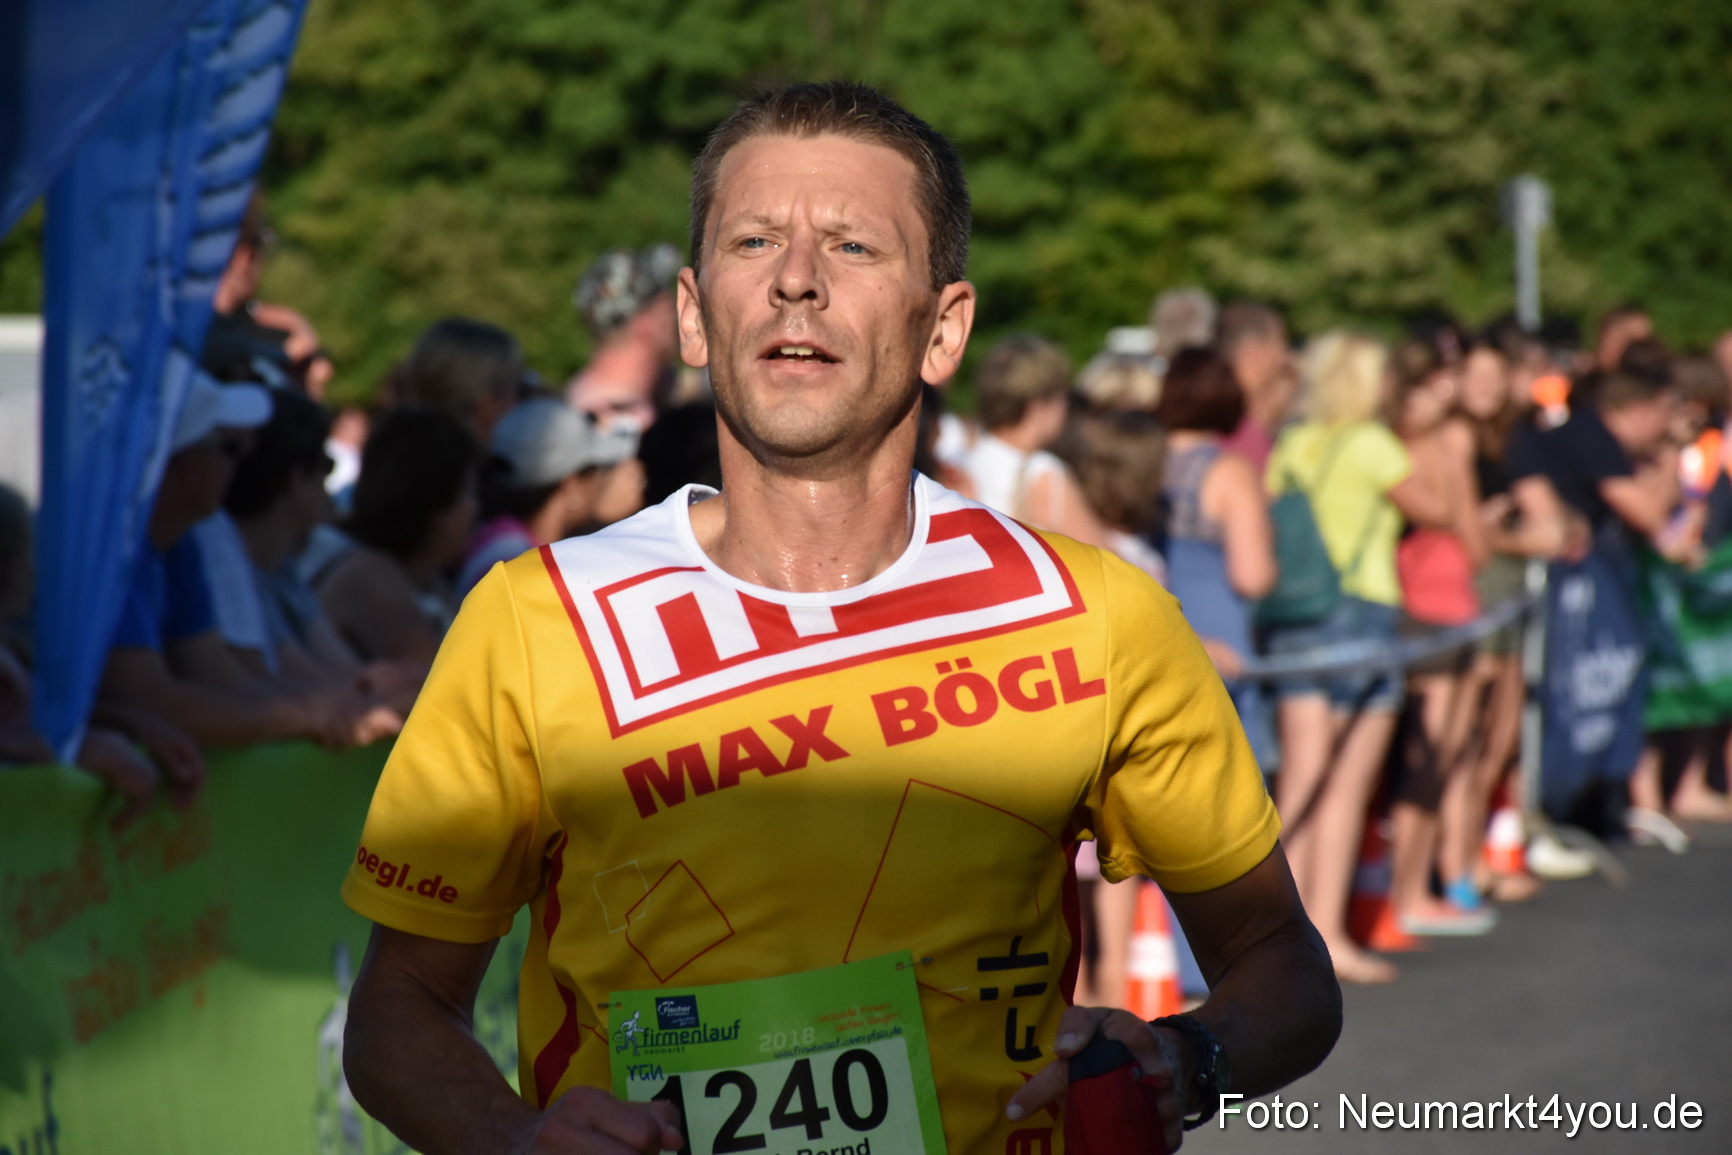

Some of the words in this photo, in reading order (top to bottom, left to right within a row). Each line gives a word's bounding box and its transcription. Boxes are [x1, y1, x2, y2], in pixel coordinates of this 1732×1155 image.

[622, 705, 851, 819] MAX
[871, 647, 1106, 747] BÖGL
[355, 843, 458, 903] oegl.de
[643, 1019, 741, 1046] firmenlauf
[644, 1046, 685, 1055] neumarkt
[759, 1027, 815, 1052] 2018
[650, 1048, 889, 1155] 1240
